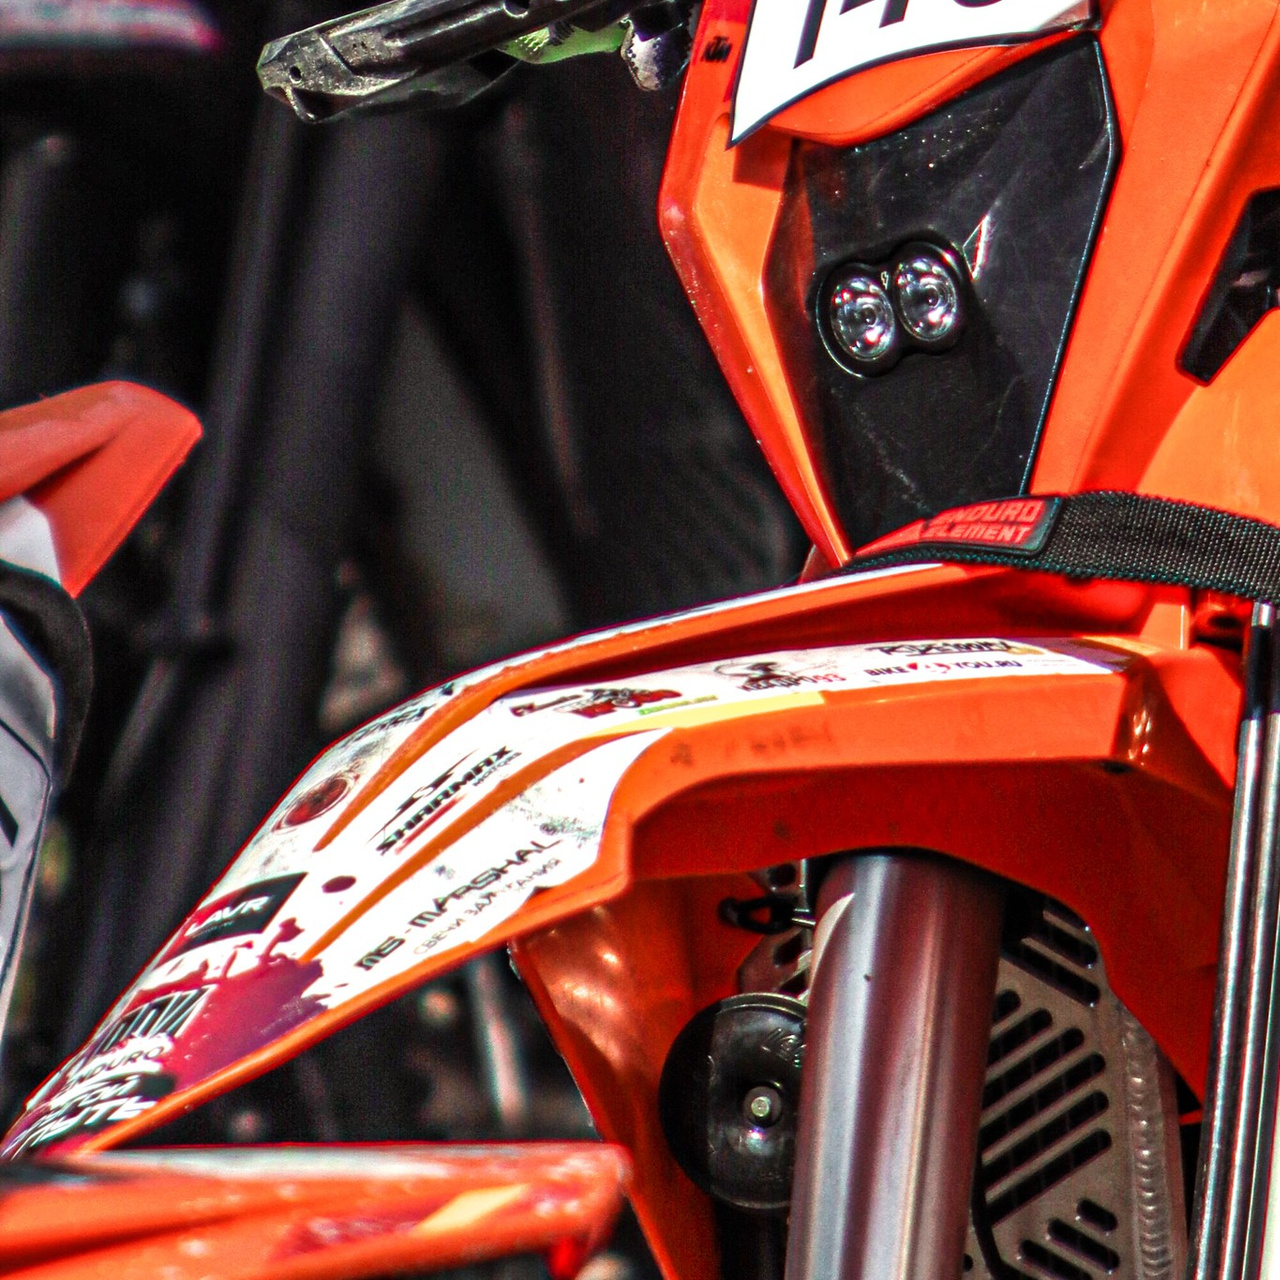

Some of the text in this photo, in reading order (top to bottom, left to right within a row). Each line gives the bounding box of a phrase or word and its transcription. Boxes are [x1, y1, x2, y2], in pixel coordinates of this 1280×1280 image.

[919, 523, 1032, 544] ELEMENT
[930, 499, 1044, 525] ENDURO
[375, 744, 514, 857] SHARMAX
[407, 838, 564, 929] MARSHAL
[183, 895, 272, 939] LAVR
